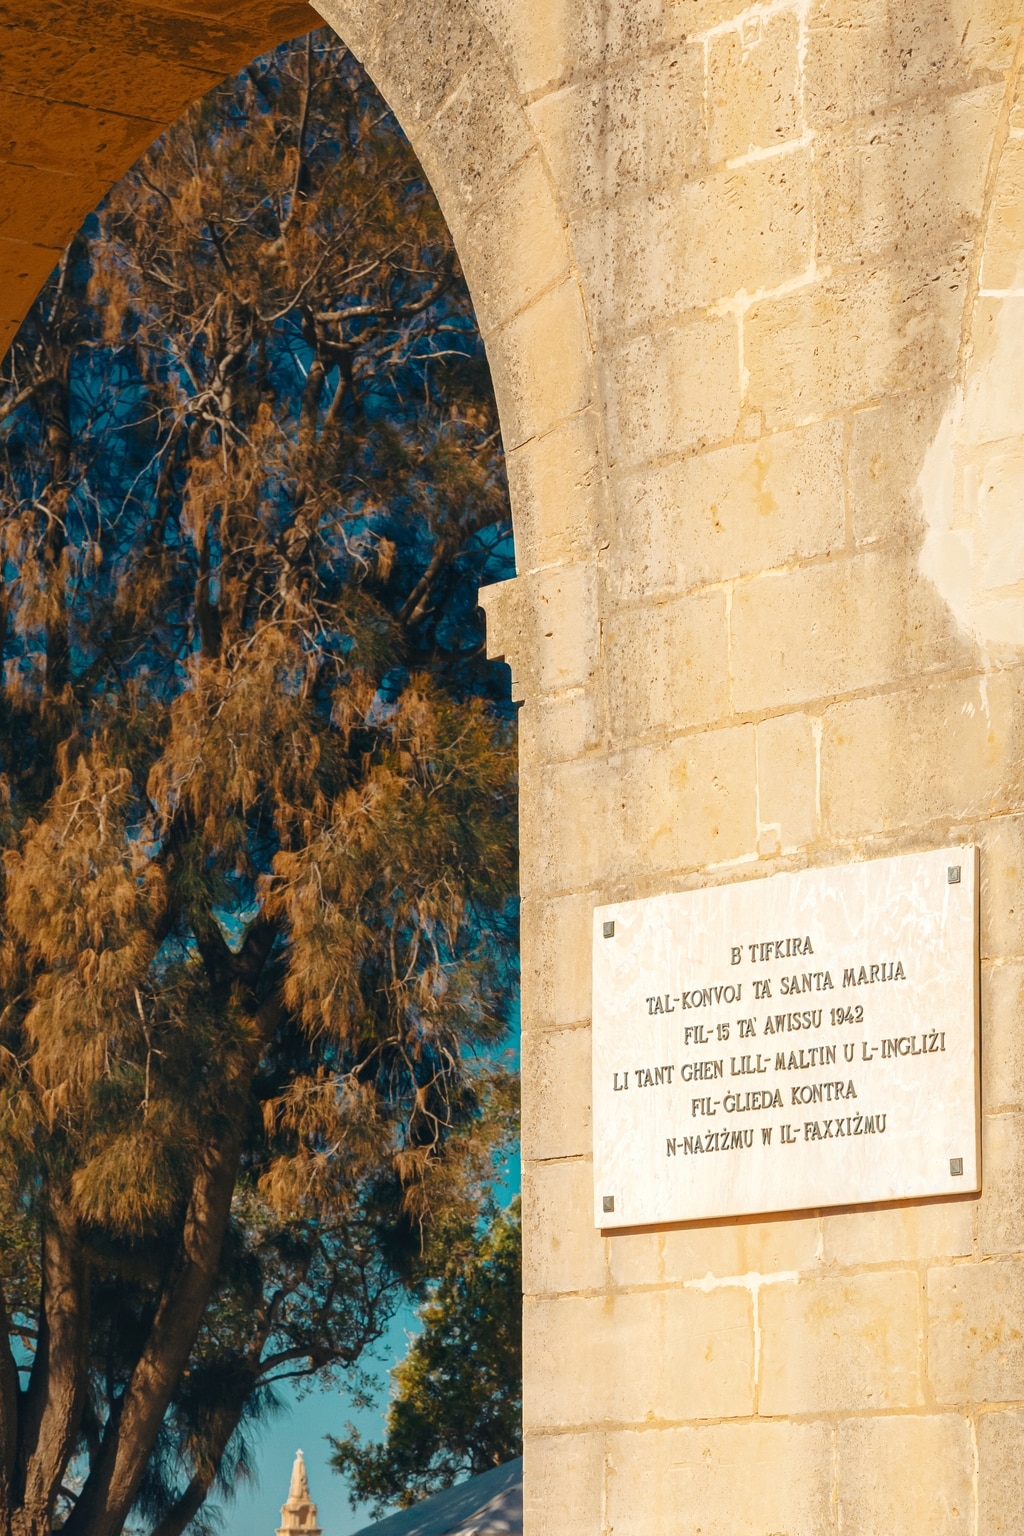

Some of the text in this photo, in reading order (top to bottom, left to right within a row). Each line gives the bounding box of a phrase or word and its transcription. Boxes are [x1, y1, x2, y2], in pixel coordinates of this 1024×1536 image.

[749, 936, 814, 962] TIFKIRA
[646, 984, 742, 1015] TAL-KONVOJ
[780, 971, 834, 995] SANTA
[842, 961, 906, 988] MARIJA
[763, 1009, 822, 1035] AWISSU
[830, 1005, 864, 1026] 1942
[613, 1072, 629, 1091] LI
[635, 1065, 674, 1088] TANT
[843, 1043, 855, 1062] U
[862, 1028, 946, 1061] L-INGLIŻI
[692, 1080, 857, 1117] FIL-ĠLIEDA KONTRA
[666, 1127, 754, 1157] N-NAŻIŻMU
[761, 1127, 772, 1145] W
